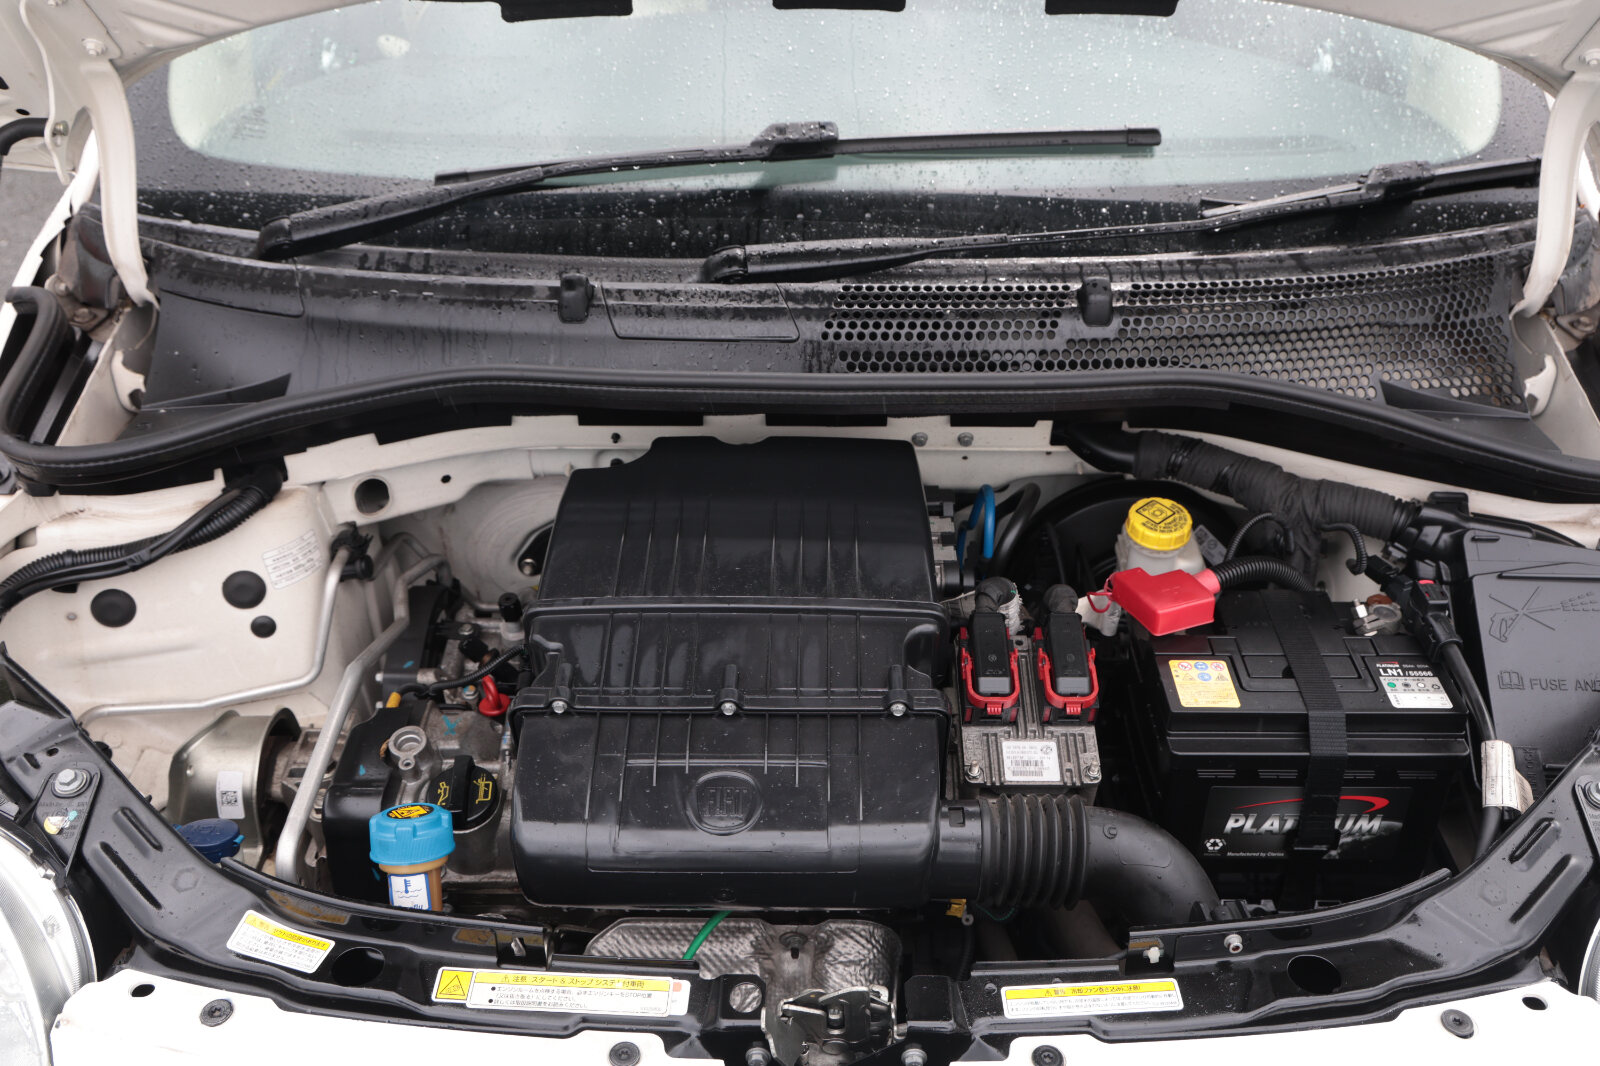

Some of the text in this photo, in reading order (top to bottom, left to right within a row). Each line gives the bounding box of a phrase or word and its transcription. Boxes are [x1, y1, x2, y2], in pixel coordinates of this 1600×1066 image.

[1379, 668, 1403, 676] LN1
[1529, 678, 1569, 691] FUSE
[1223, 813, 1384, 835] PLATUM
[531, 976, 558, 984] スタート
[568, 978, 645, 988] ストップシステ付車両
